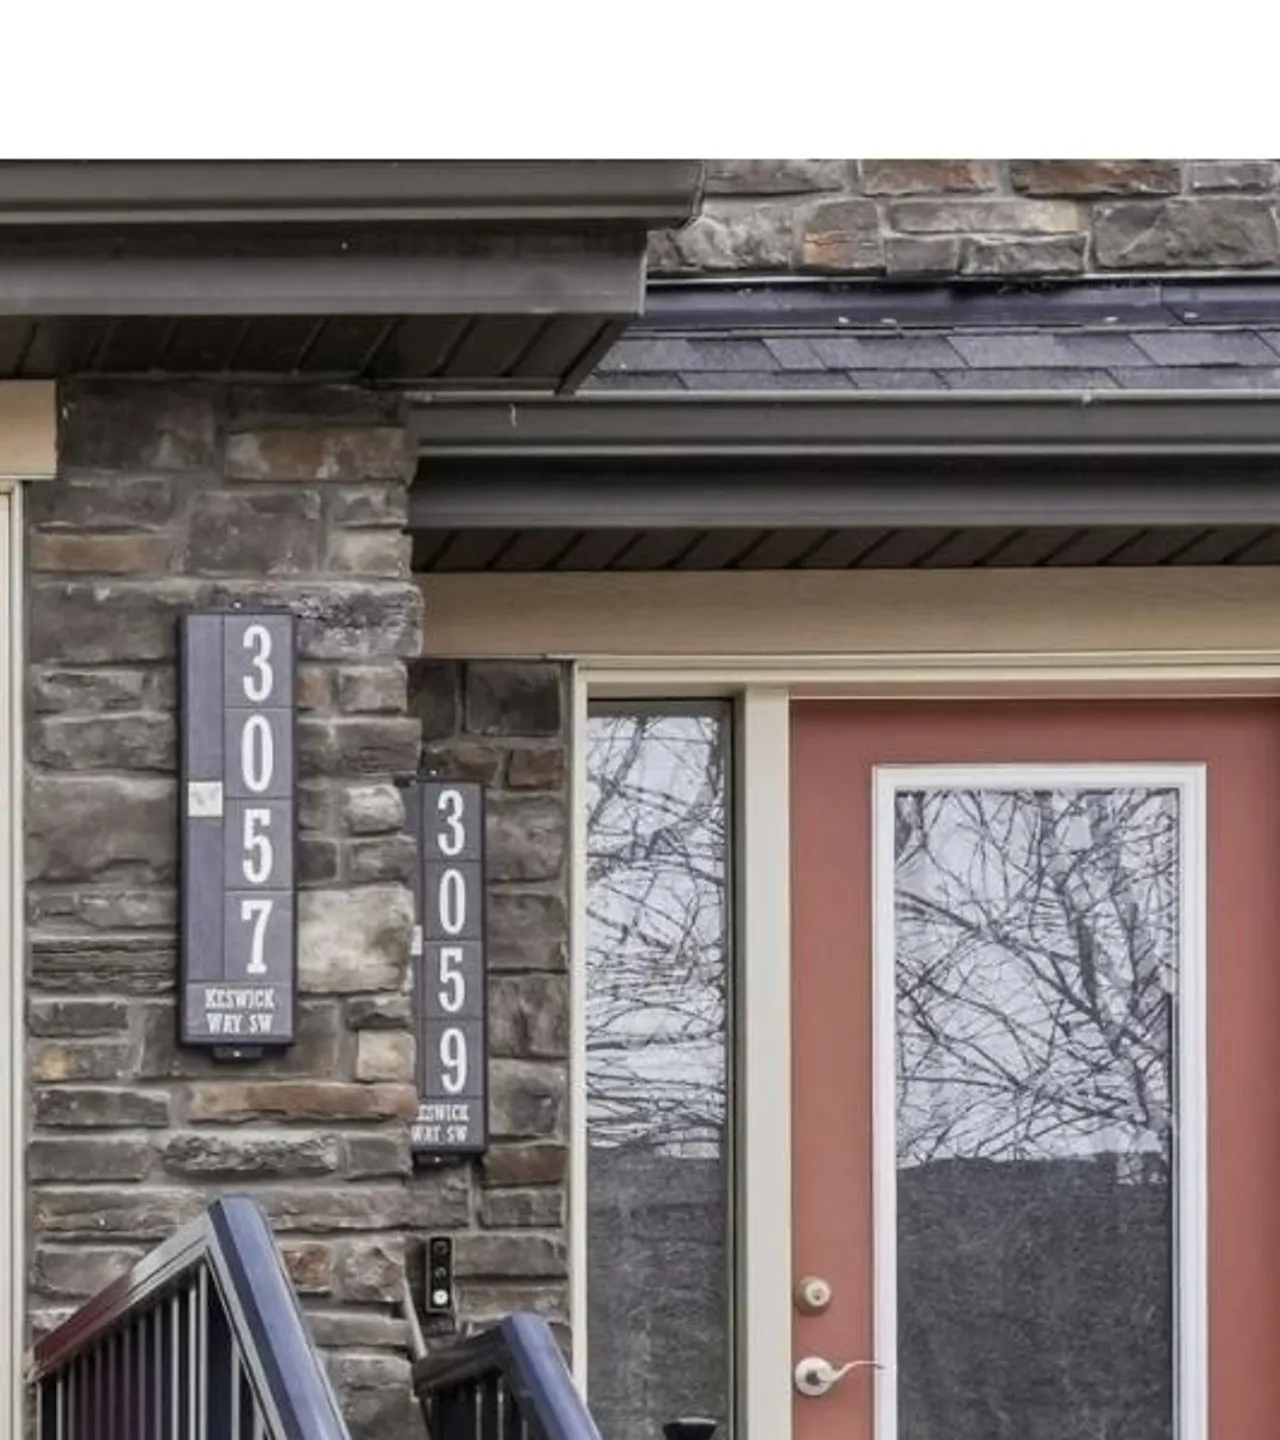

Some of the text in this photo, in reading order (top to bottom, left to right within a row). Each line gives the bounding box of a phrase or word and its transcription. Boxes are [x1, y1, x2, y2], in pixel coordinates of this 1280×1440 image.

[240, 624, 274, 974] 3057
[437, 789, 468, 1092] 3059
[204, 988, 275, 1009] KESWICK
[206, 1012, 274, 1034] WAY SW
[416, 1104, 470, 1122] ESWICK
[446, 1125, 468, 1142] SW
